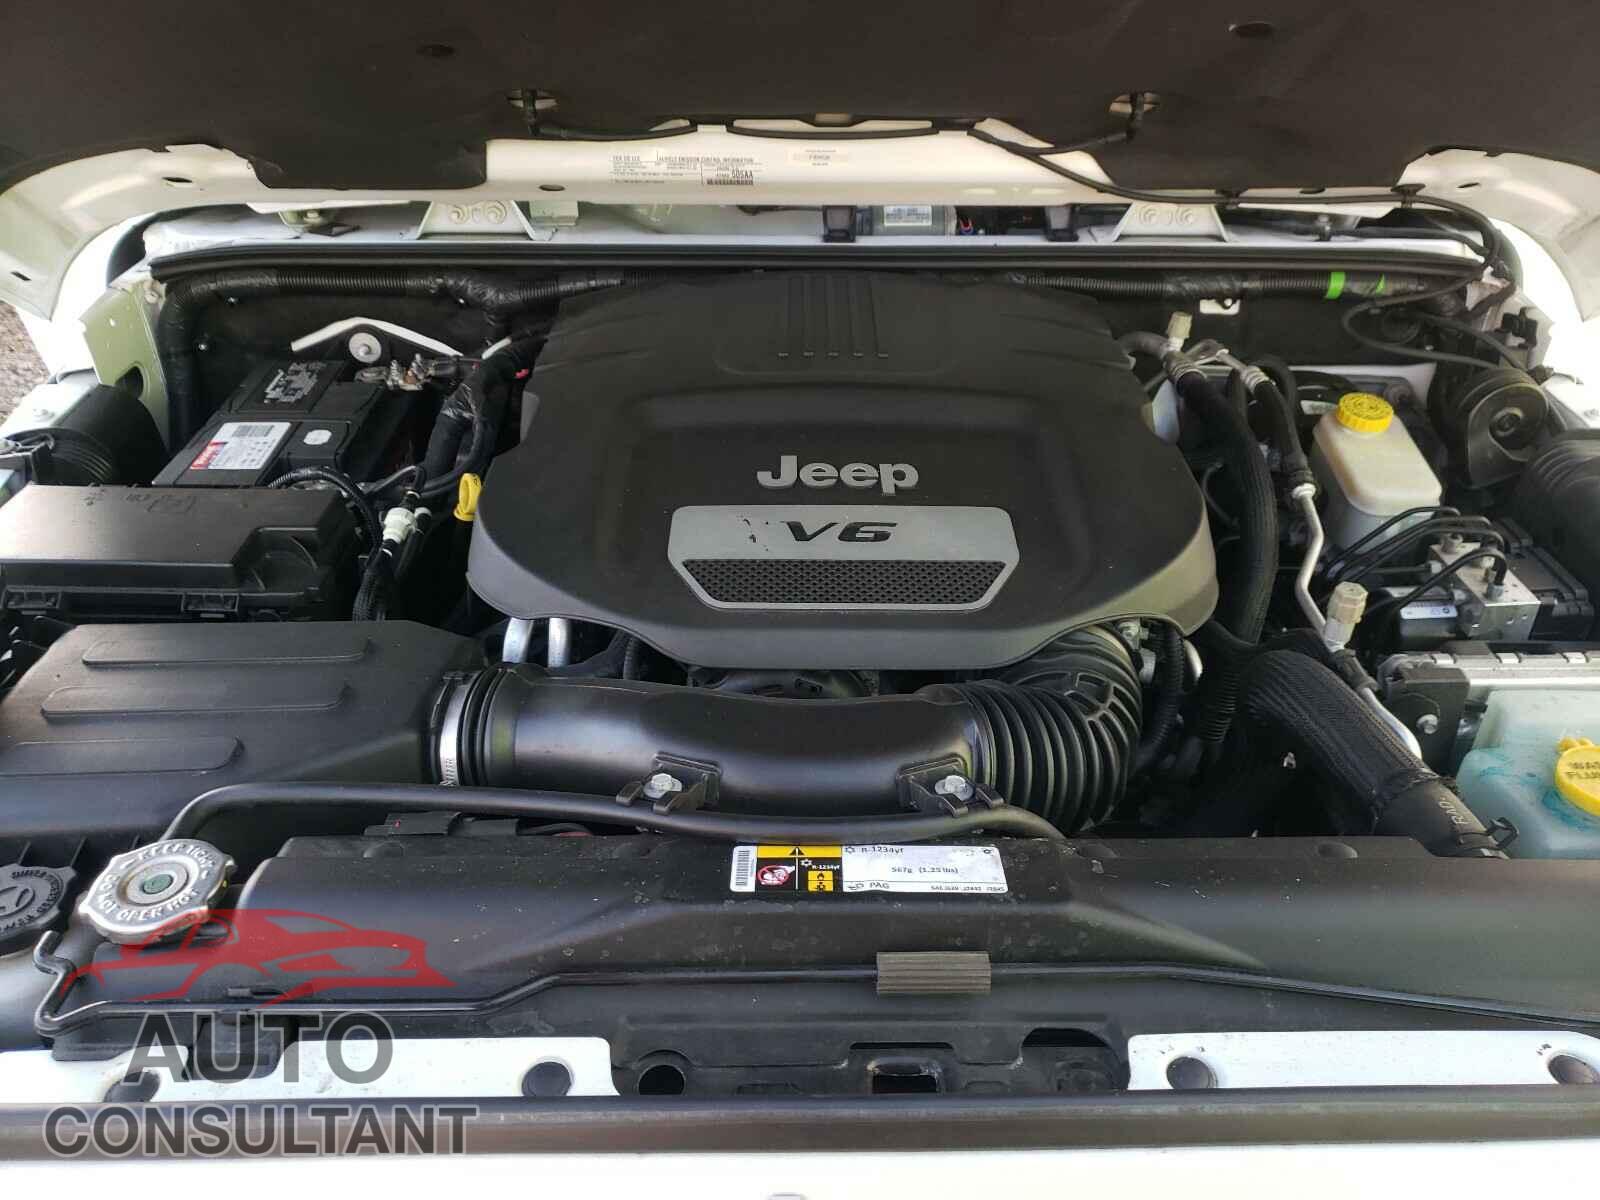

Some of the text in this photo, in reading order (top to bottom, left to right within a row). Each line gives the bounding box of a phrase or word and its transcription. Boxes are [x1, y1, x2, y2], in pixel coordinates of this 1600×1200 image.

[757, 455, 920, 495] Jeep
[780, 521, 898, 543] V6
[116, 907, 164, 921] OPEN
